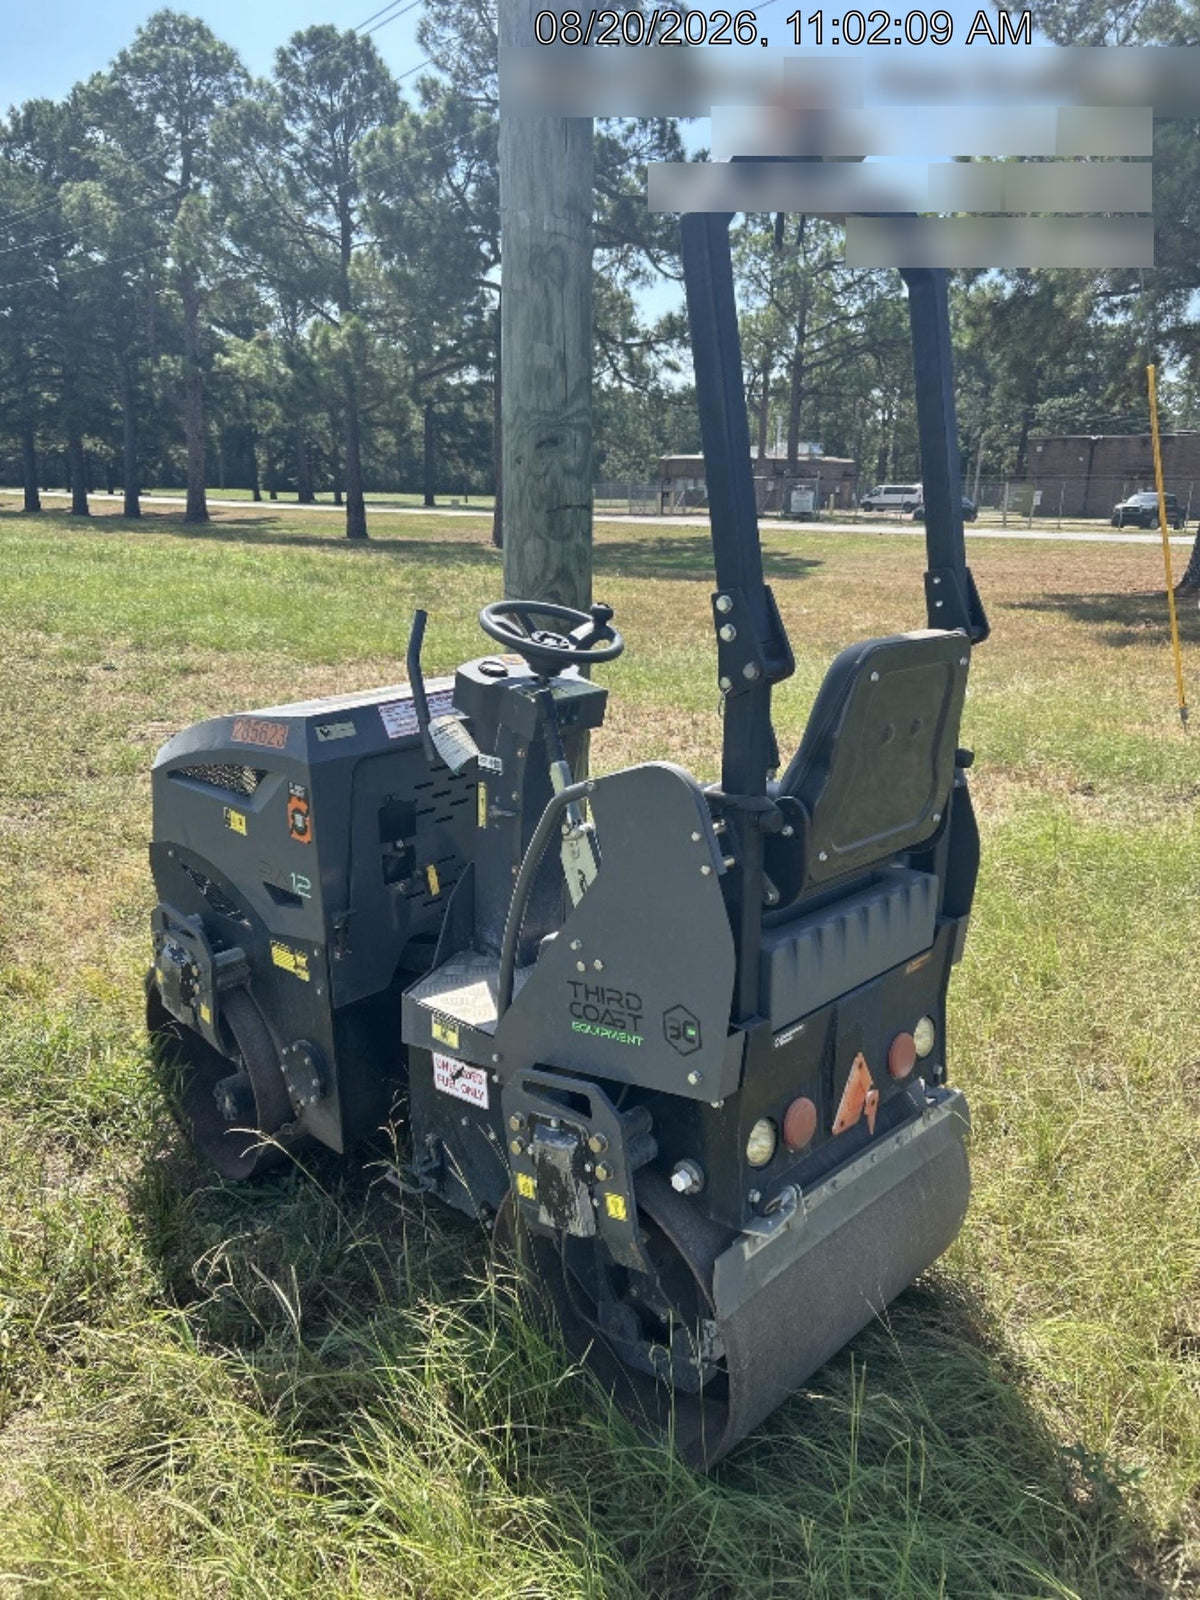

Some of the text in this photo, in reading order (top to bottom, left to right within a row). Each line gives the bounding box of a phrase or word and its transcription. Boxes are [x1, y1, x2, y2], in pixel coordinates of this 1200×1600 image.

[566, 980, 643, 1012] THIRD
[569, 1001, 644, 1032] COAST
[571, 1021, 644, 1047] EQUIPMENT
[460, 1083, 485, 1101] ONLY
